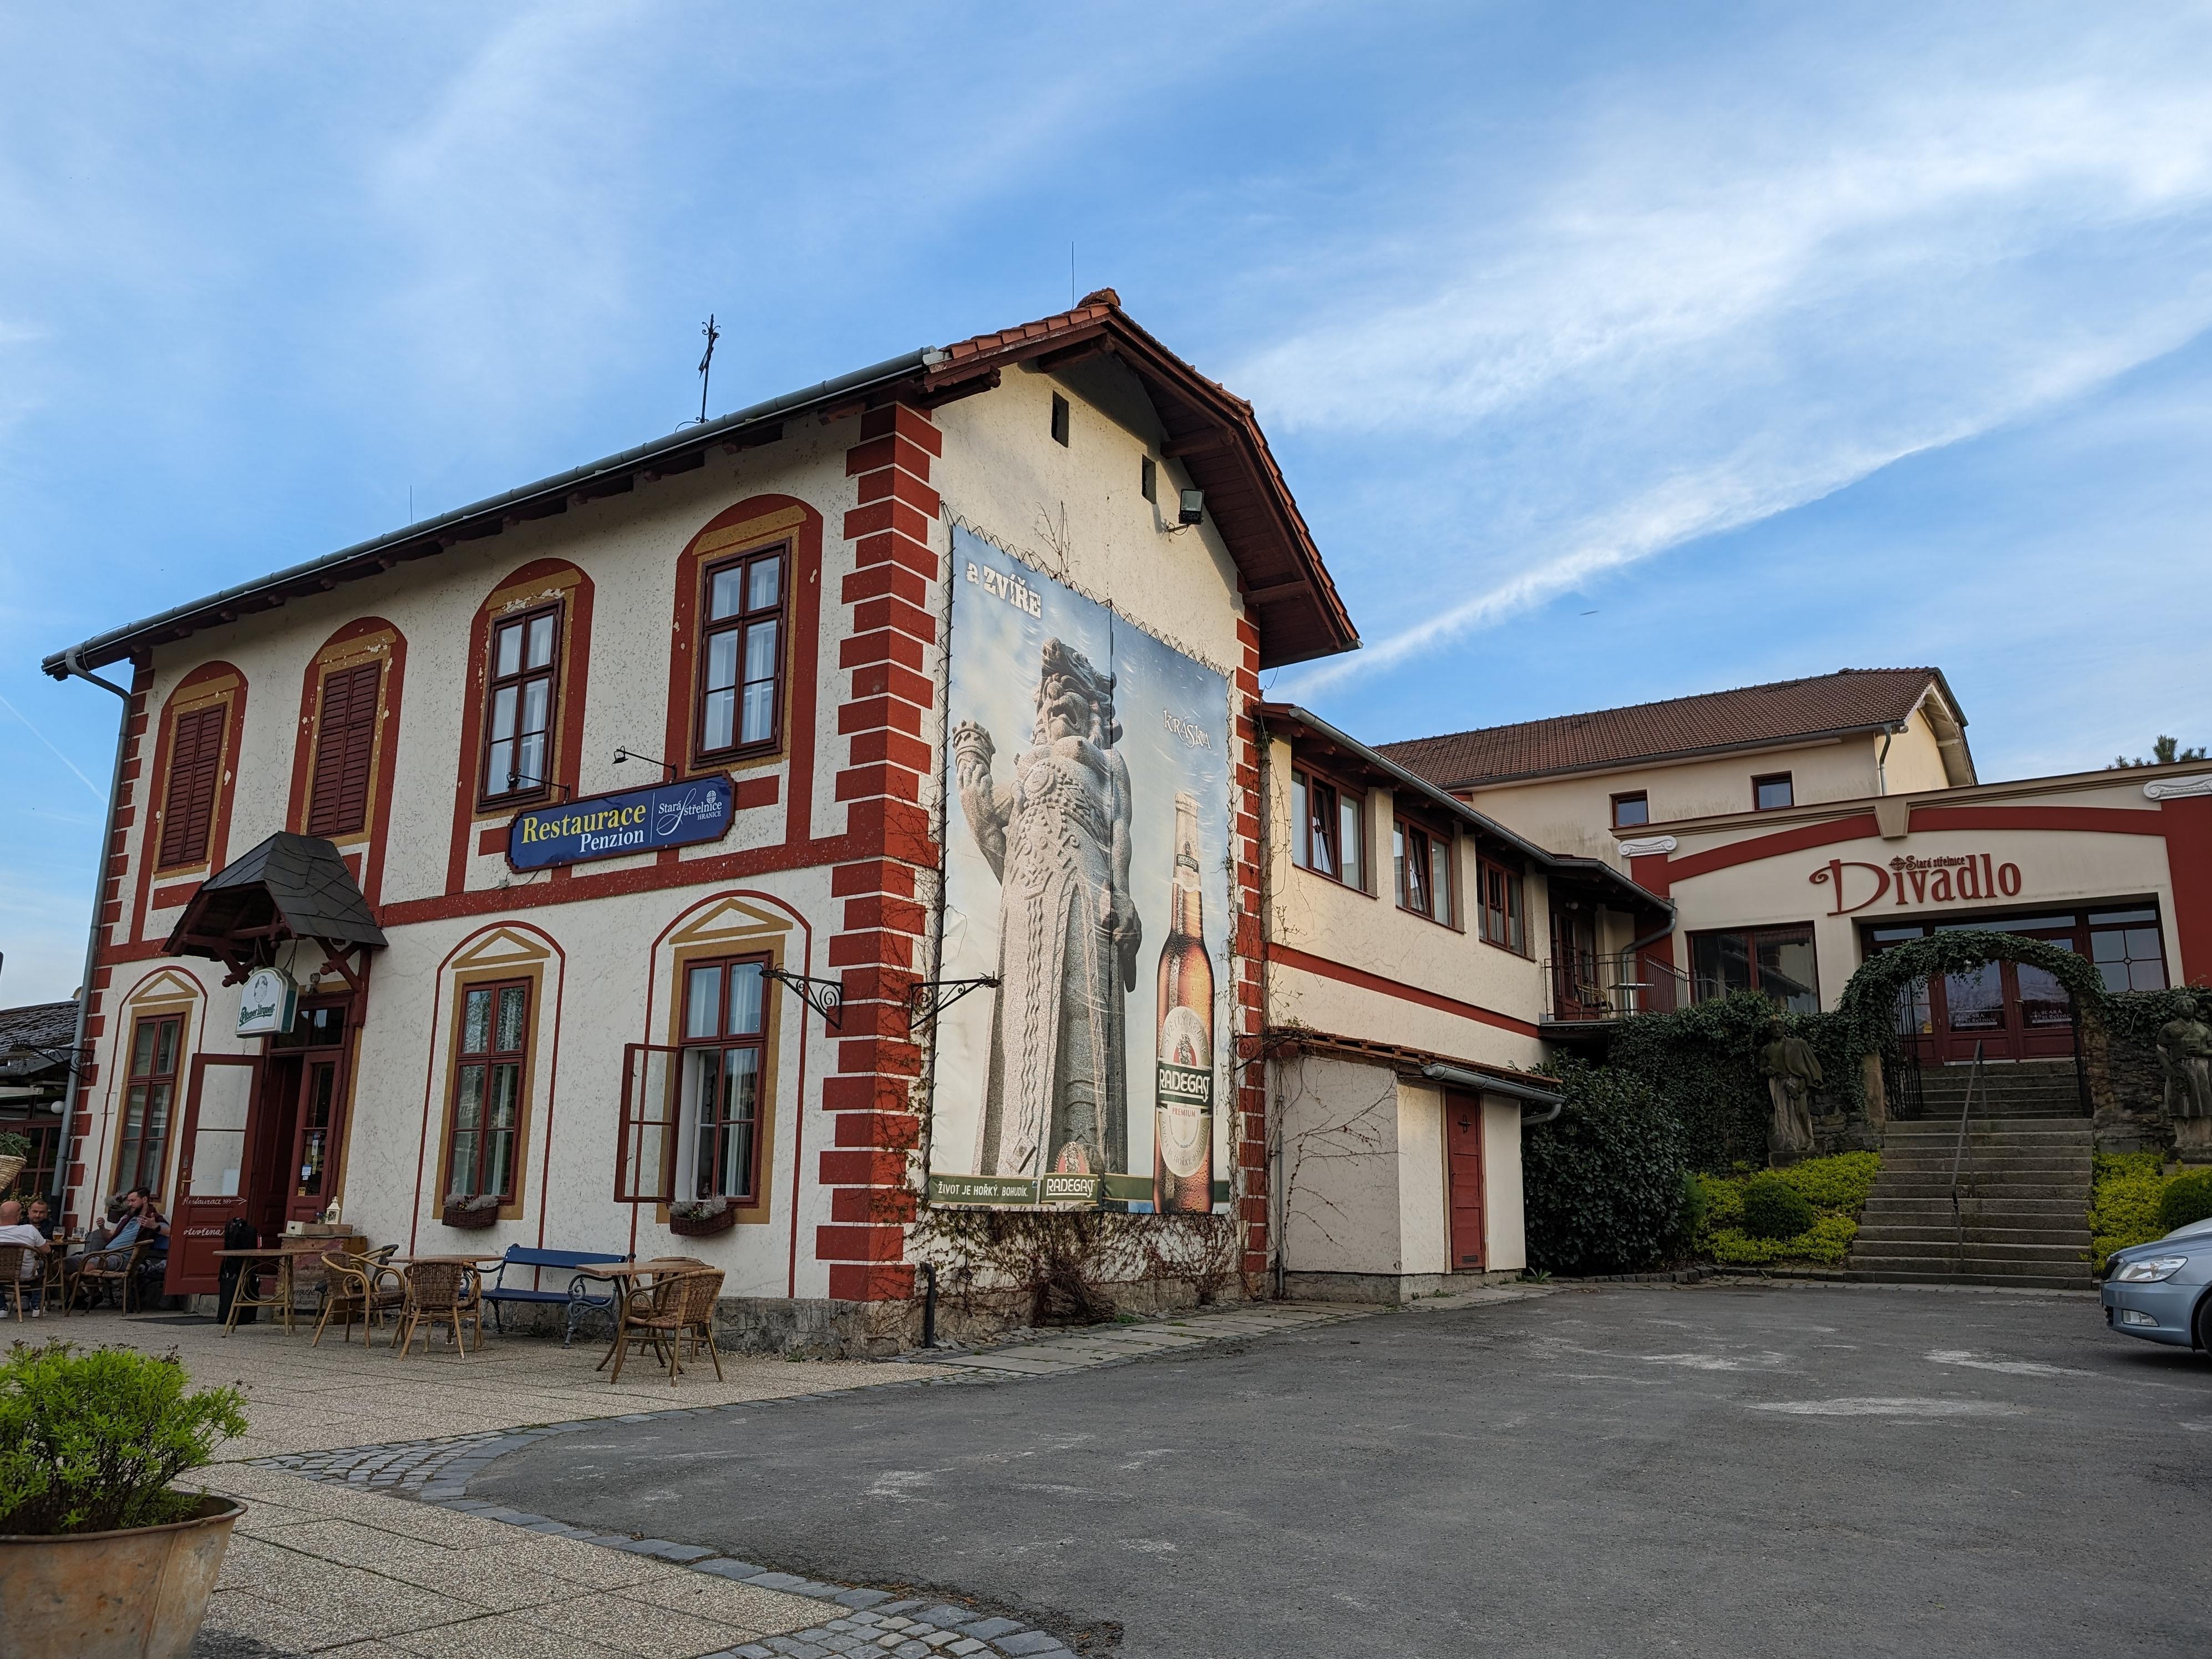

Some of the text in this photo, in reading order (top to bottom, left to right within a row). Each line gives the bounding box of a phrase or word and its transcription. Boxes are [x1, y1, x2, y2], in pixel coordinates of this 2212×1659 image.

[658, 800, 722, 816] Stará střelnice
[697, 810, 722, 820] HRANICE
[521, 805, 646, 844] Restaurace
[580, 827, 644, 853] Penzion
[1906, 855, 1932, 870] Stará
[1809, 853, 2021, 916] Divadlo
[1159, 1068, 1210, 1103] RADEGAST
[1172, 1107, 1196, 1118] PREMIUM
[938, 1181, 1028, 1197] ŽIVOT JE HOŘKÝ. BOHUDÍK.
[1046, 1178, 1095, 1198] RADEGAST
